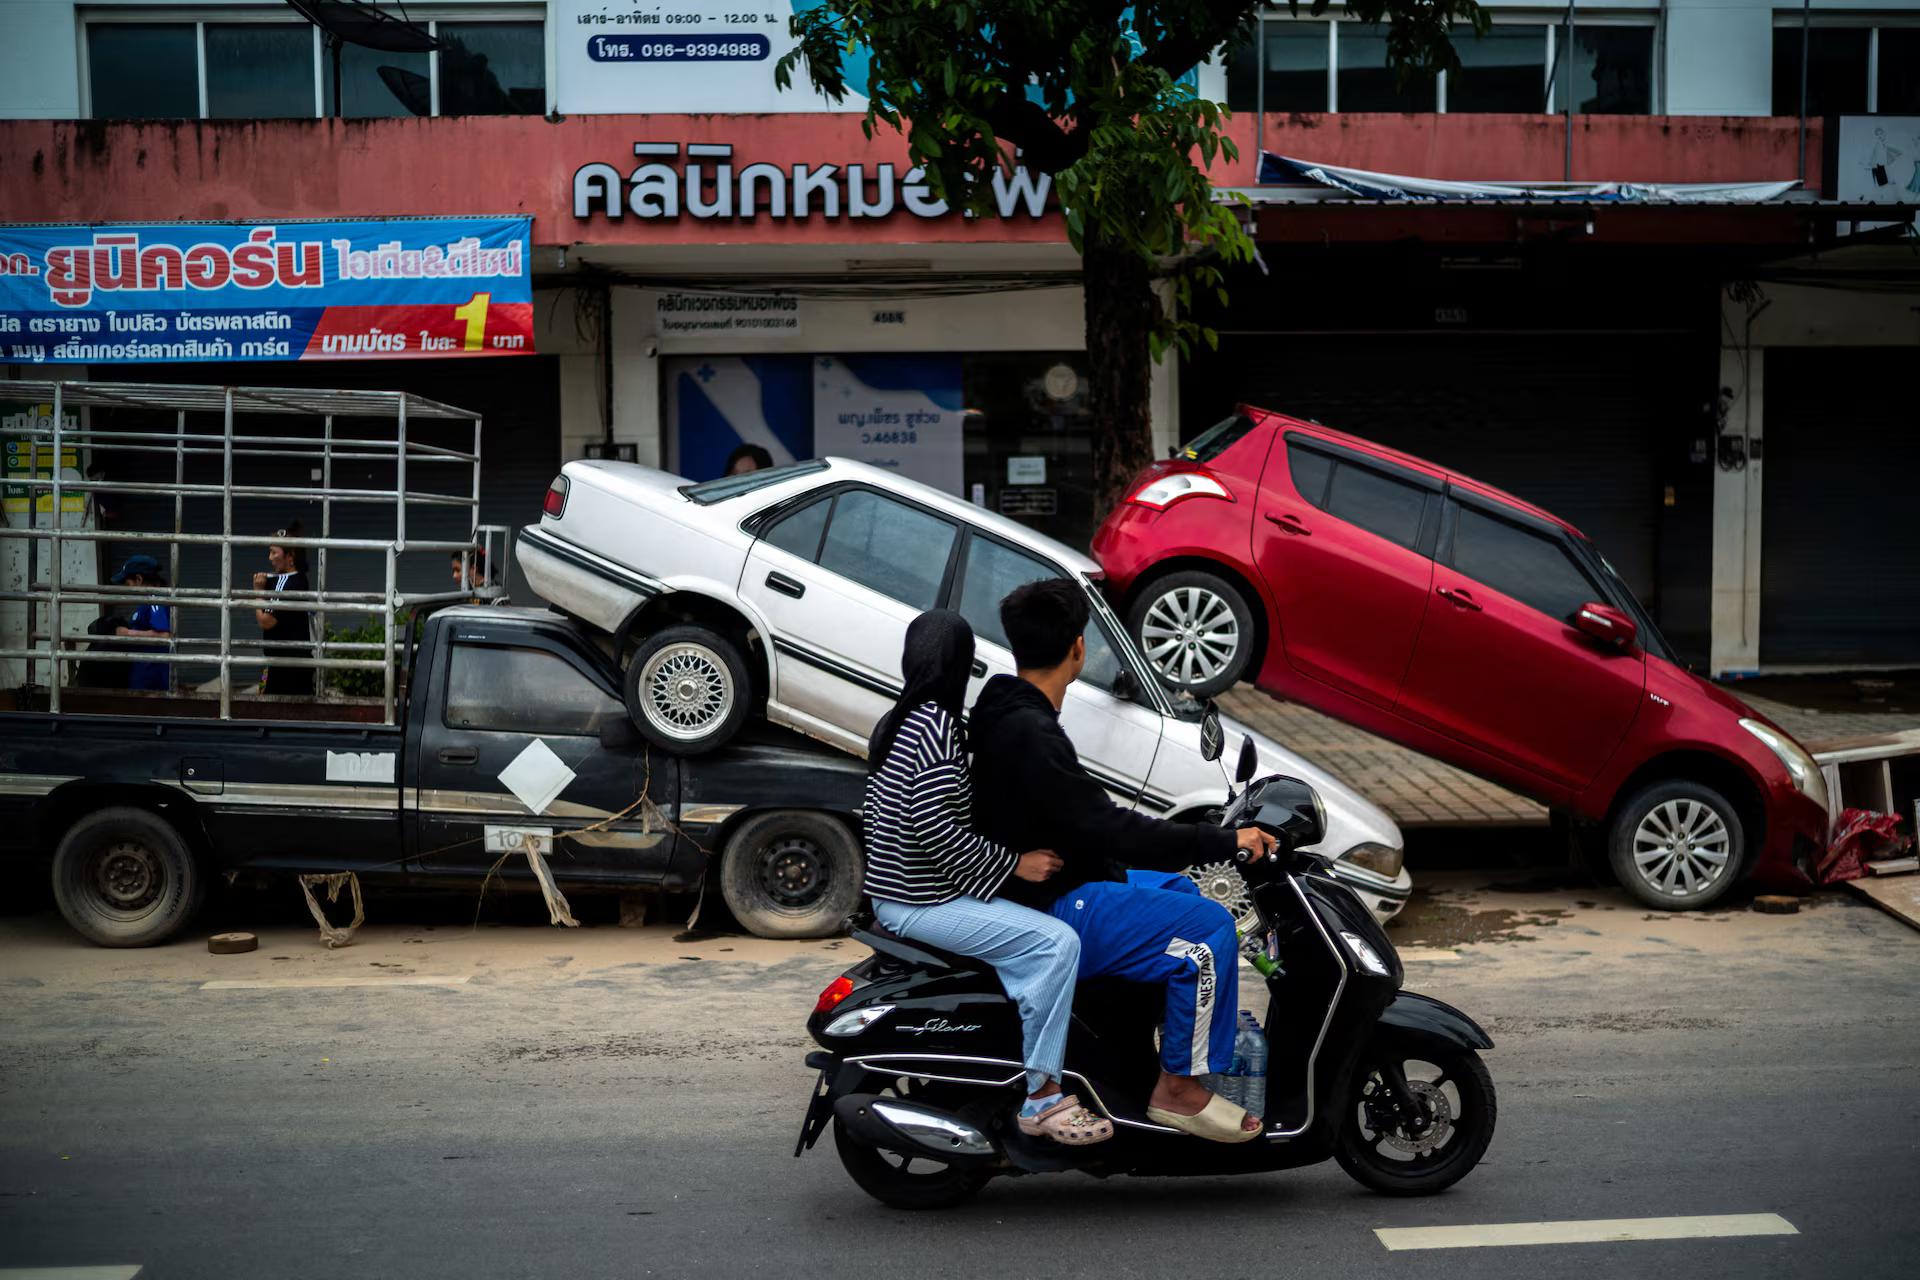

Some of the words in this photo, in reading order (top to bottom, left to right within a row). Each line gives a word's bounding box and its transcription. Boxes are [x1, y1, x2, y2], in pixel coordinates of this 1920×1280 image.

[577, 7, 660, 24] เสาร์-อาทิตย์
[666, 14, 701, 24] 09:00
[724, 14, 758, 23] 12.00
[596, 38, 634, 58] โทร.
[641, 43, 761, 57] 096-9394988
[44, 227, 324, 308] ยูนิคอร์น
[331, 237, 523, 281] ไอเดีย&ดีไซน์
[29, 318, 100, 332] ตรายาง
[106, 311, 167, 332] ใบปลิว
[176, 311, 291, 331] บัตรพลาสติก
[322, 328, 406, 352] นามบัตร
[420, 330, 457, 351] ใบละ
[454, 292, 491, 352] 1
[493, 334, 524, 349] บาท
[12, 345, 45, 362] เมนู
[241, 337, 289, 356] การ์ด
